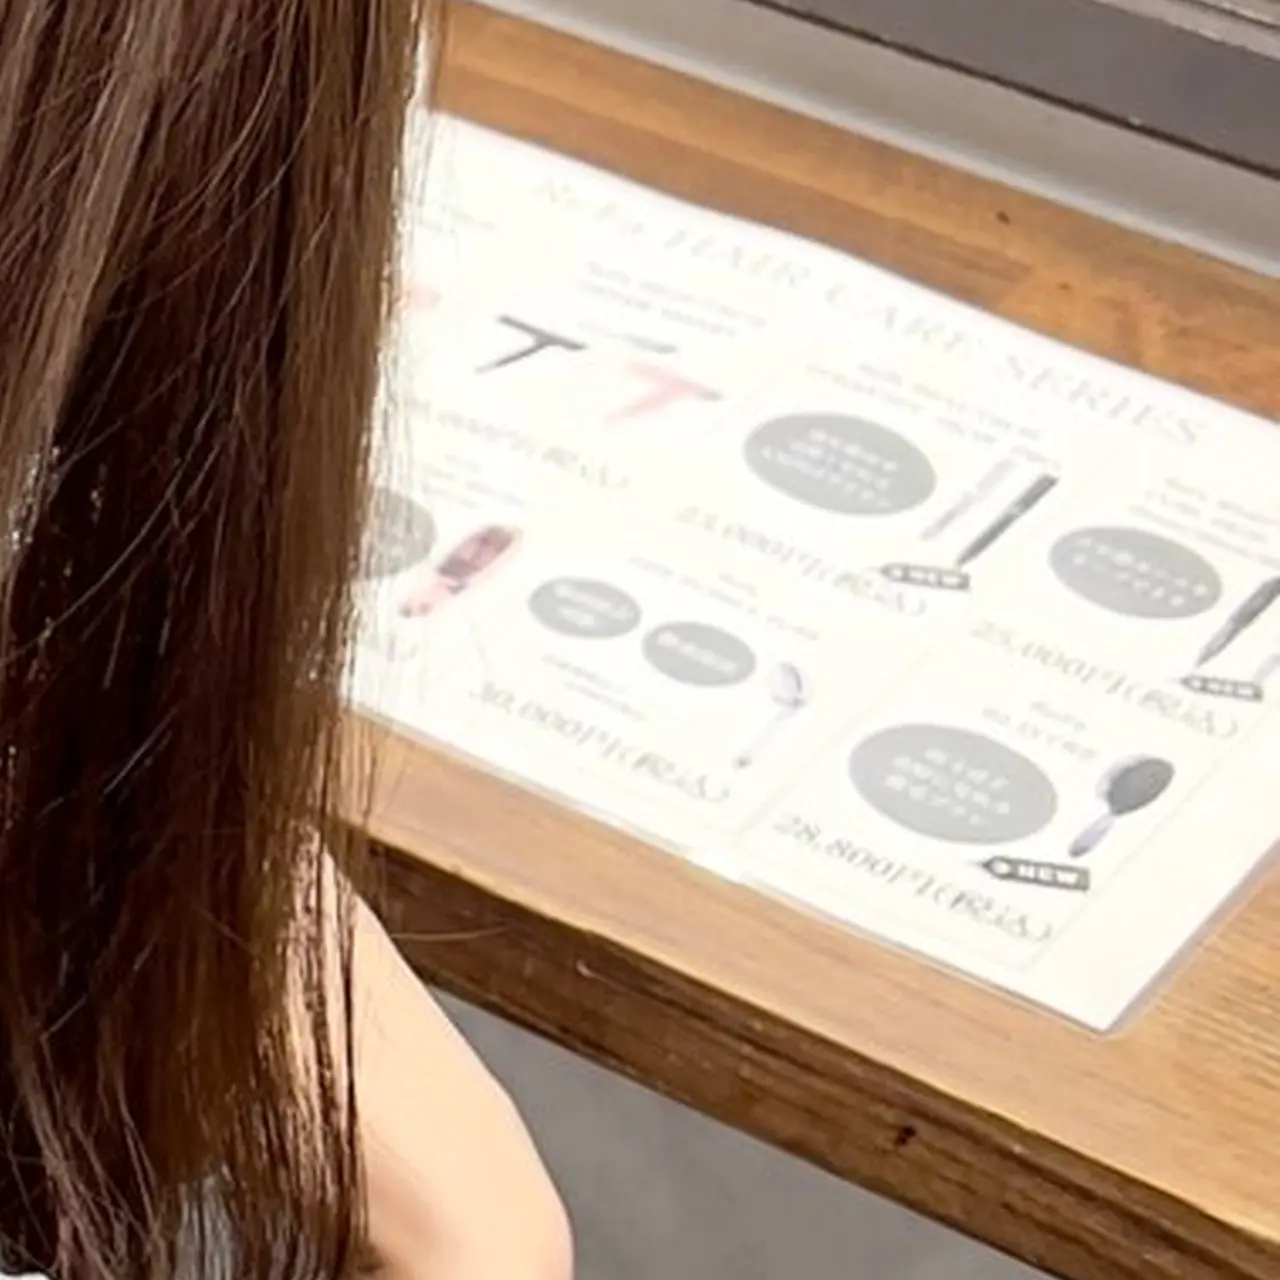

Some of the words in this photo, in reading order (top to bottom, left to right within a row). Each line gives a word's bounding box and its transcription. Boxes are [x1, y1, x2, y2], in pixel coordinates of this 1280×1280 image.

[825, 278, 989, 363] CARE
[995, 350, 1212, 449] SERIES
[1017, 864, 1080, 886] NEW
